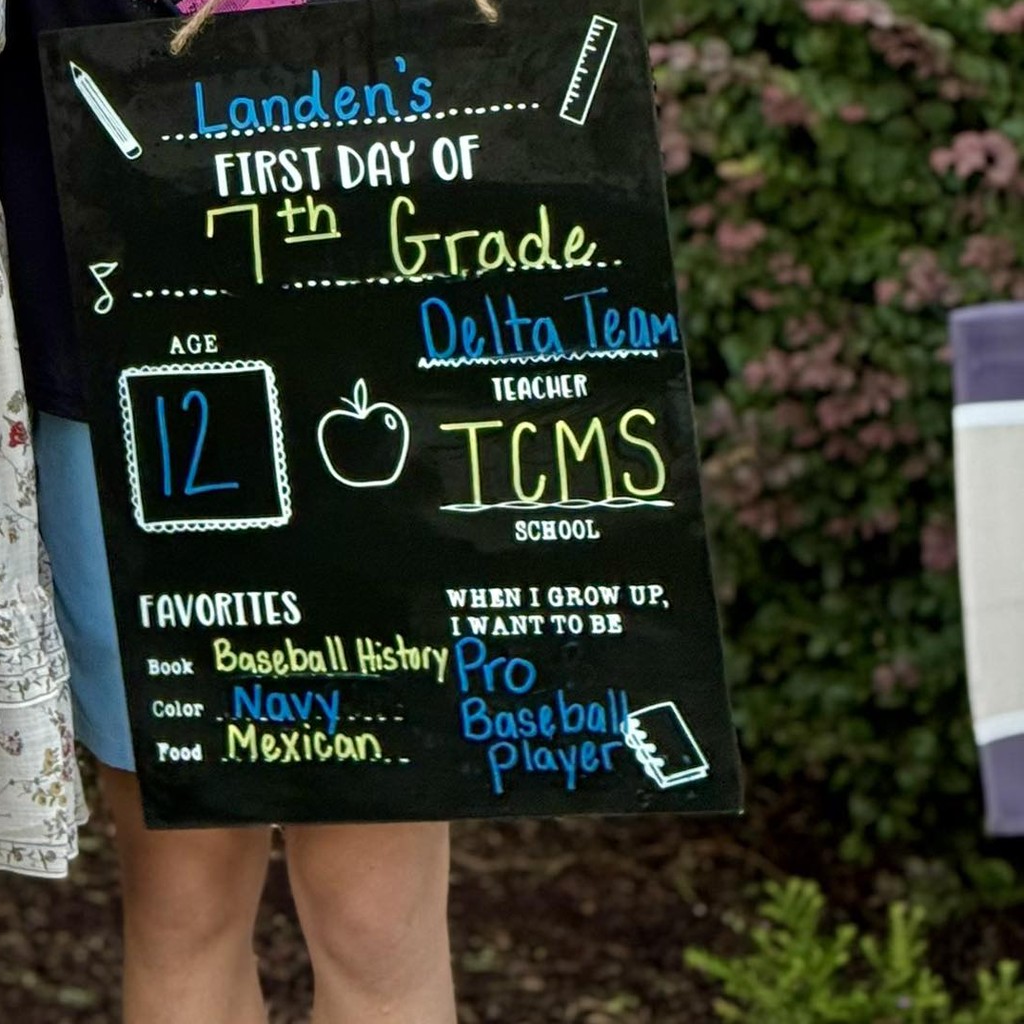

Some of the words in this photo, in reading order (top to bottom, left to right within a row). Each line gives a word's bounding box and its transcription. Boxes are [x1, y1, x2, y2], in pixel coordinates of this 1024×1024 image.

[194, 56, 433, 135] Landen's
[214, 146, 322, 197] FIRST
[339, 140, 416, 191] DAY
[432, 134, 481, 182] OF
[205, 196, 341, 284] 7th
[389, 195, 598, 277] Grade
[169, 334, 219, 355] AGE
[418, 294, 563, 360] Delta
[563, 286, 679, 351] Team
[491, 374, 589, 402] TEACHER
[155, 389, 239, 496] 12
[439, 408, 667, 508] TCMS
[514, 519, 601, 542] SCHOOL
[138, 589, 302, 628] FAVORITES
[446, 587, 521, 608] WHEN
[529, 587, 541, 607] I
[547, 585, 620, 607] GROW
[629, 584, 670, 609] UP,
[450, 616, 461, 636] I
[467, 615, 545, 636] WANT
[550, 614, 584, 635] TO
[588, 613, 624, 634] BE
[147, 658, 194, 676] Book
[212, 635, 348, 675] Baseball
[356, 633, 449, 683] History
[454, 636, 537, 694] Pro
[152, 699, 205, 718] Color
[232, 683, 340, 735] Navy
[460, 688, 628, 740] Baseball
[156, 742, 204, 762] Food
[227, 723, 383, 763] Mexican
